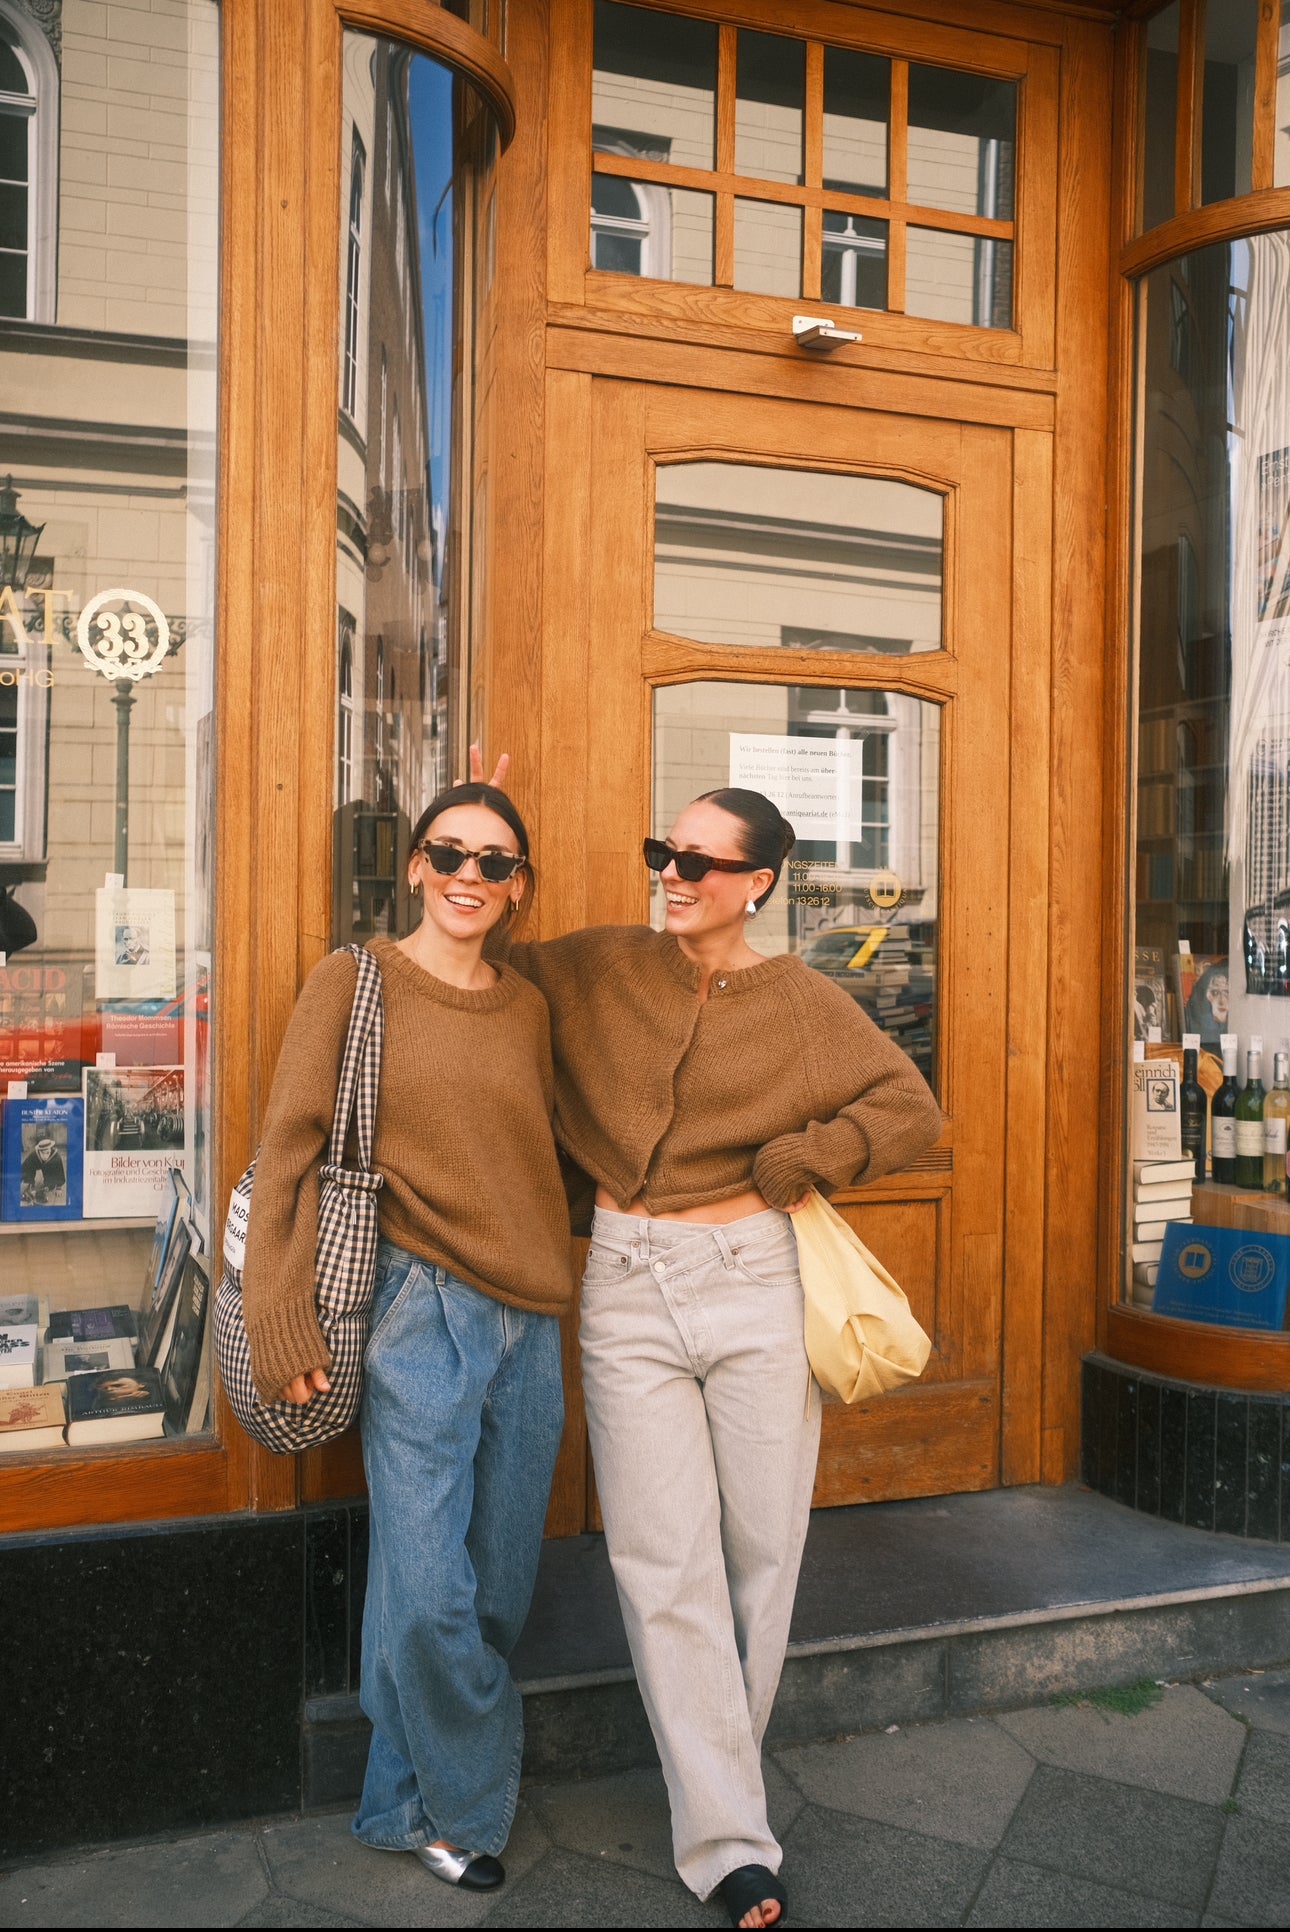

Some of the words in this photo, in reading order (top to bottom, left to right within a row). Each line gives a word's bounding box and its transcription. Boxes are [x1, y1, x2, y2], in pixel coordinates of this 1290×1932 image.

[97, 612, 149, 658] 33
[0, 669, 55, 688] oHG
[753, 746, 779, 754] bestellen
[798, 748, 808, 756] alle
[782, 809, 828, 818] antiquariat.de
[785, 860, 842, 870] NGSZEITEN
[793, 883, 842, 893] 11.00-16.00
[768, 896, 795, 905] elefon
[110, 1015, 137, 1023] Theodor
[106, 1022, 138, 1031] Römische
[138, 1022, 176, 1030] Geschichte
[1133, 1065, 1177, 1079] einrich
[111, 1156, 141, 1169] Bilder
[142, 1160, 163, 1168] von
[89, 1169, 125, 1178] Fotografie
[126, 1169, 141, 1177] und
[142, 1168, 169, 1177] Geschi
[114, 1176, 168, 1185] Industriezeitalt
[232, 1203, 249, 1221] MADS
[226, 1218, 246, 1243] RGAAR
